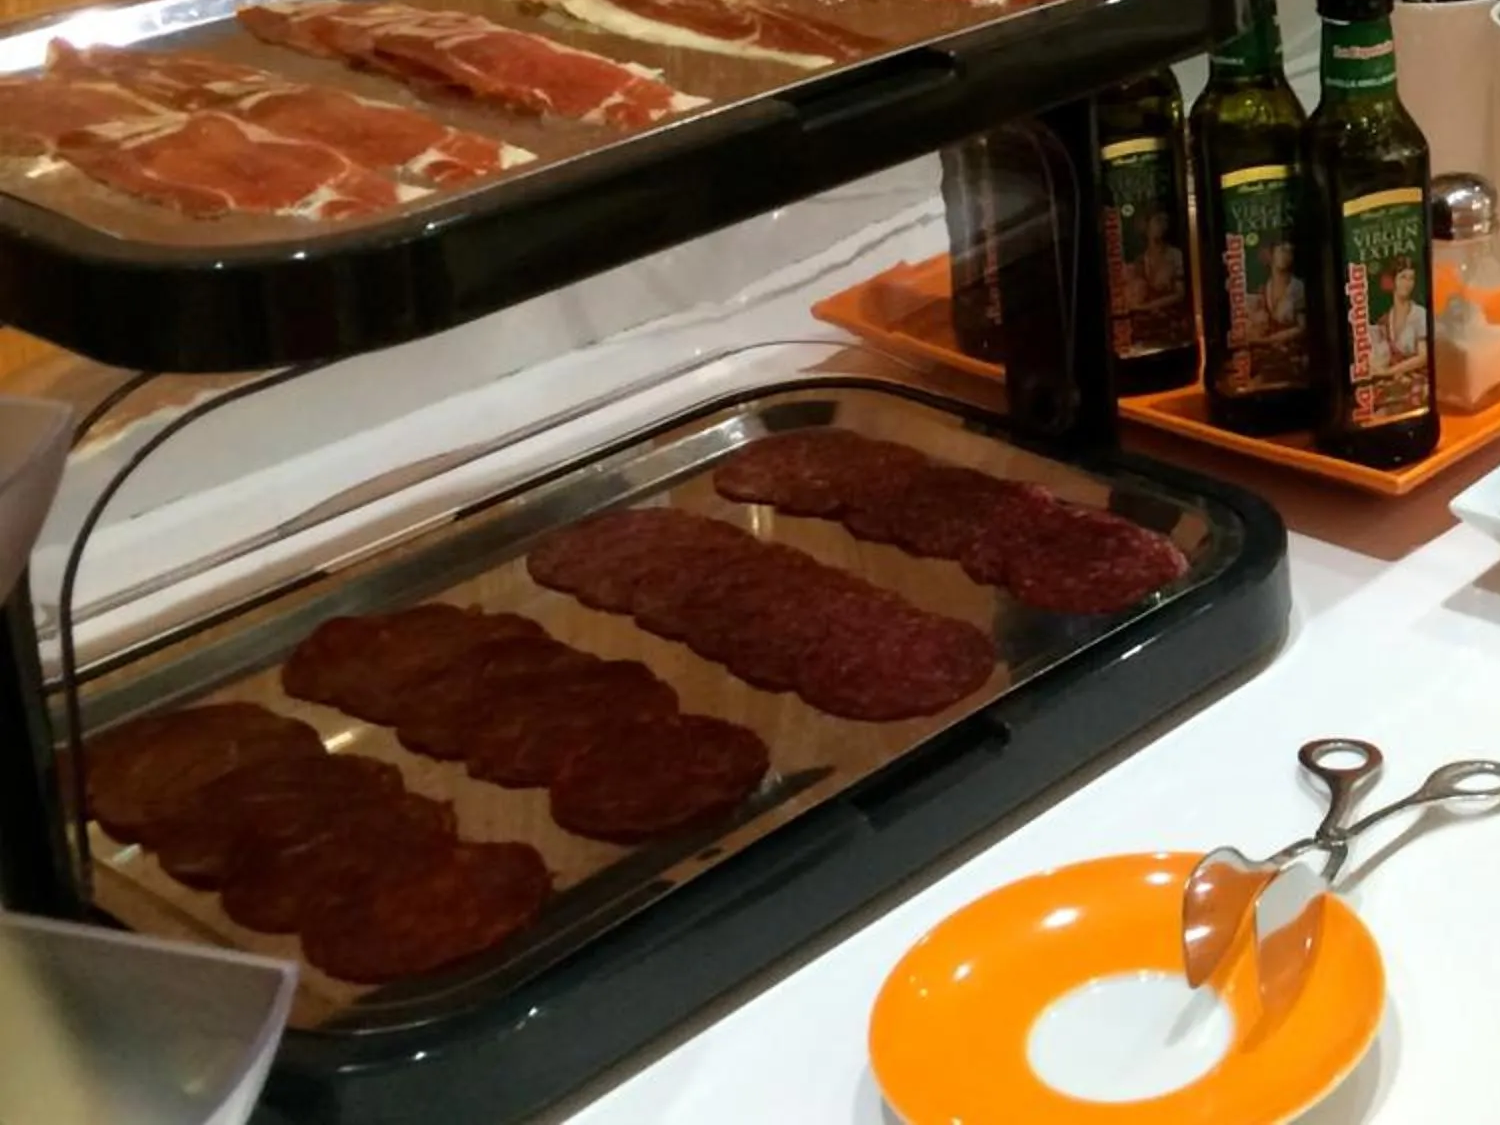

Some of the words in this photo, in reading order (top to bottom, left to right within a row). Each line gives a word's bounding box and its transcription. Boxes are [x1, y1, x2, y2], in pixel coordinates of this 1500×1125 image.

[1352, 223, 1418, 248] VIRGEN
[1359, 239, 1416, 262] EXTRA
[1345, 263, 1372, 381] Española
